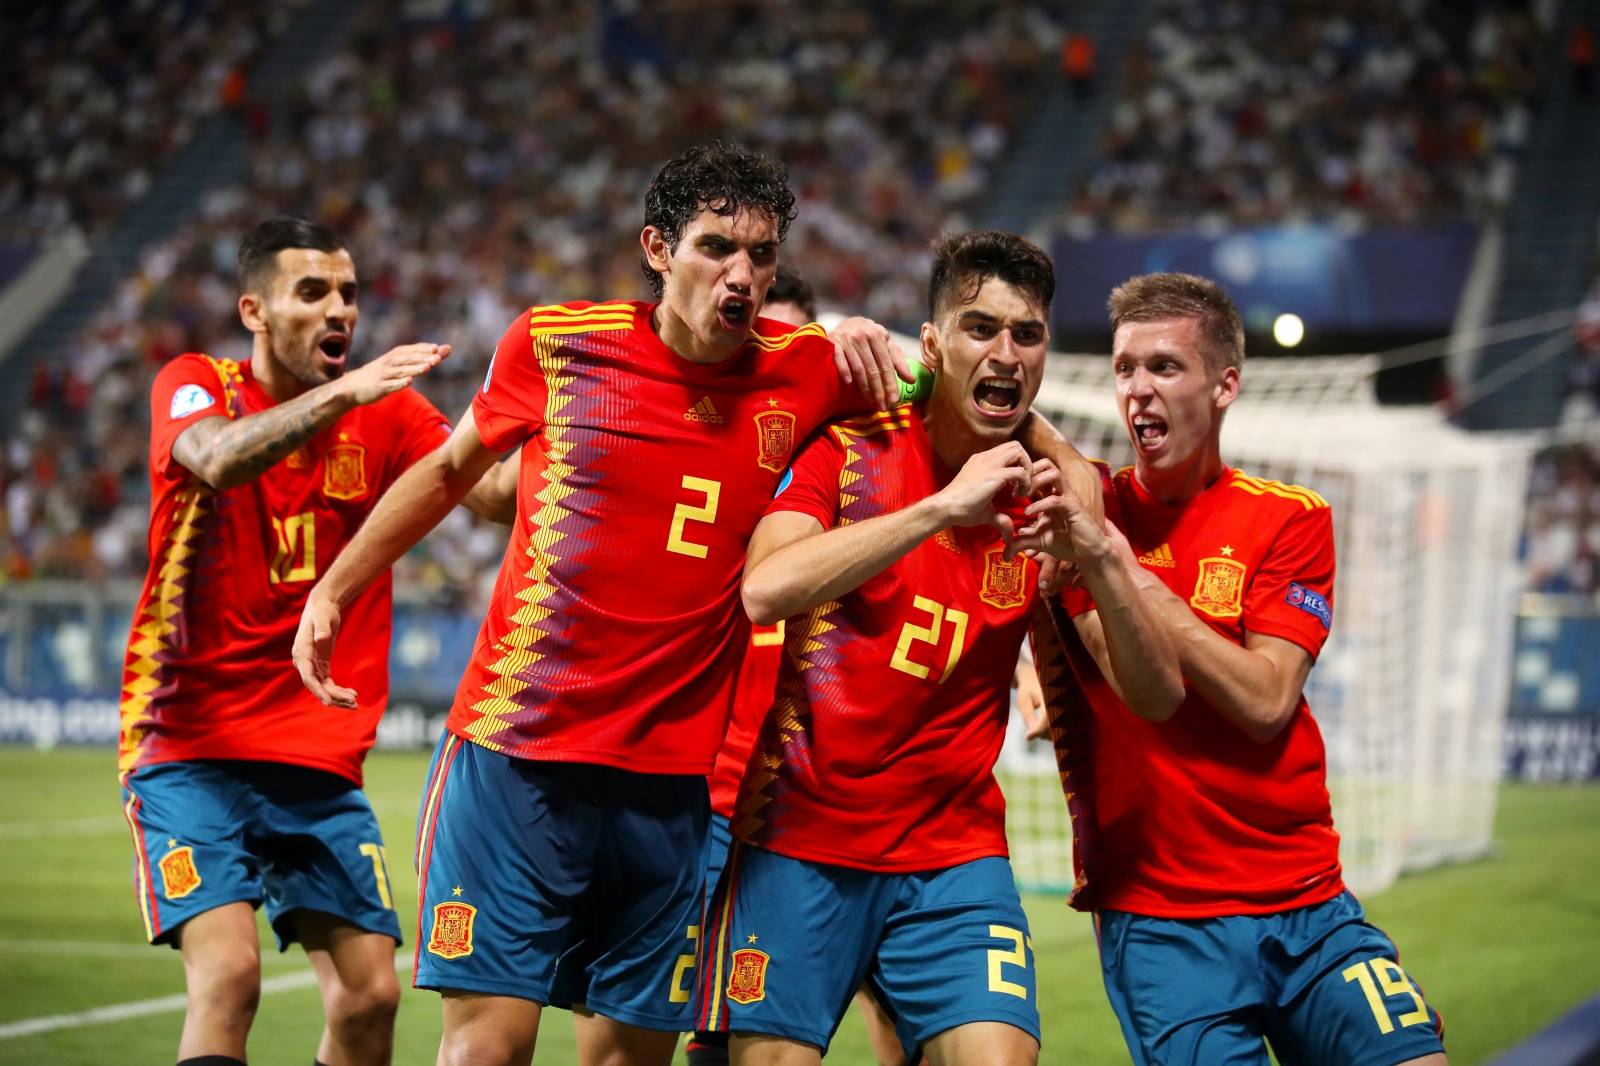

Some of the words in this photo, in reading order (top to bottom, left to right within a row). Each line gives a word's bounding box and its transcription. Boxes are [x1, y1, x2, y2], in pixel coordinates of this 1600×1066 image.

[683, 411, 730, 425] adidas
[270, 511, 316, 584] 10
[666, 475, 721, 560] 2
[1138, 555, 1176, 568] adidas
[889, 594, 969, 685] 21
[358, 842, 392, 911] 1
[987, 924, 1034, 1001] 2
[1342, 957, 1431, 1035] 19
